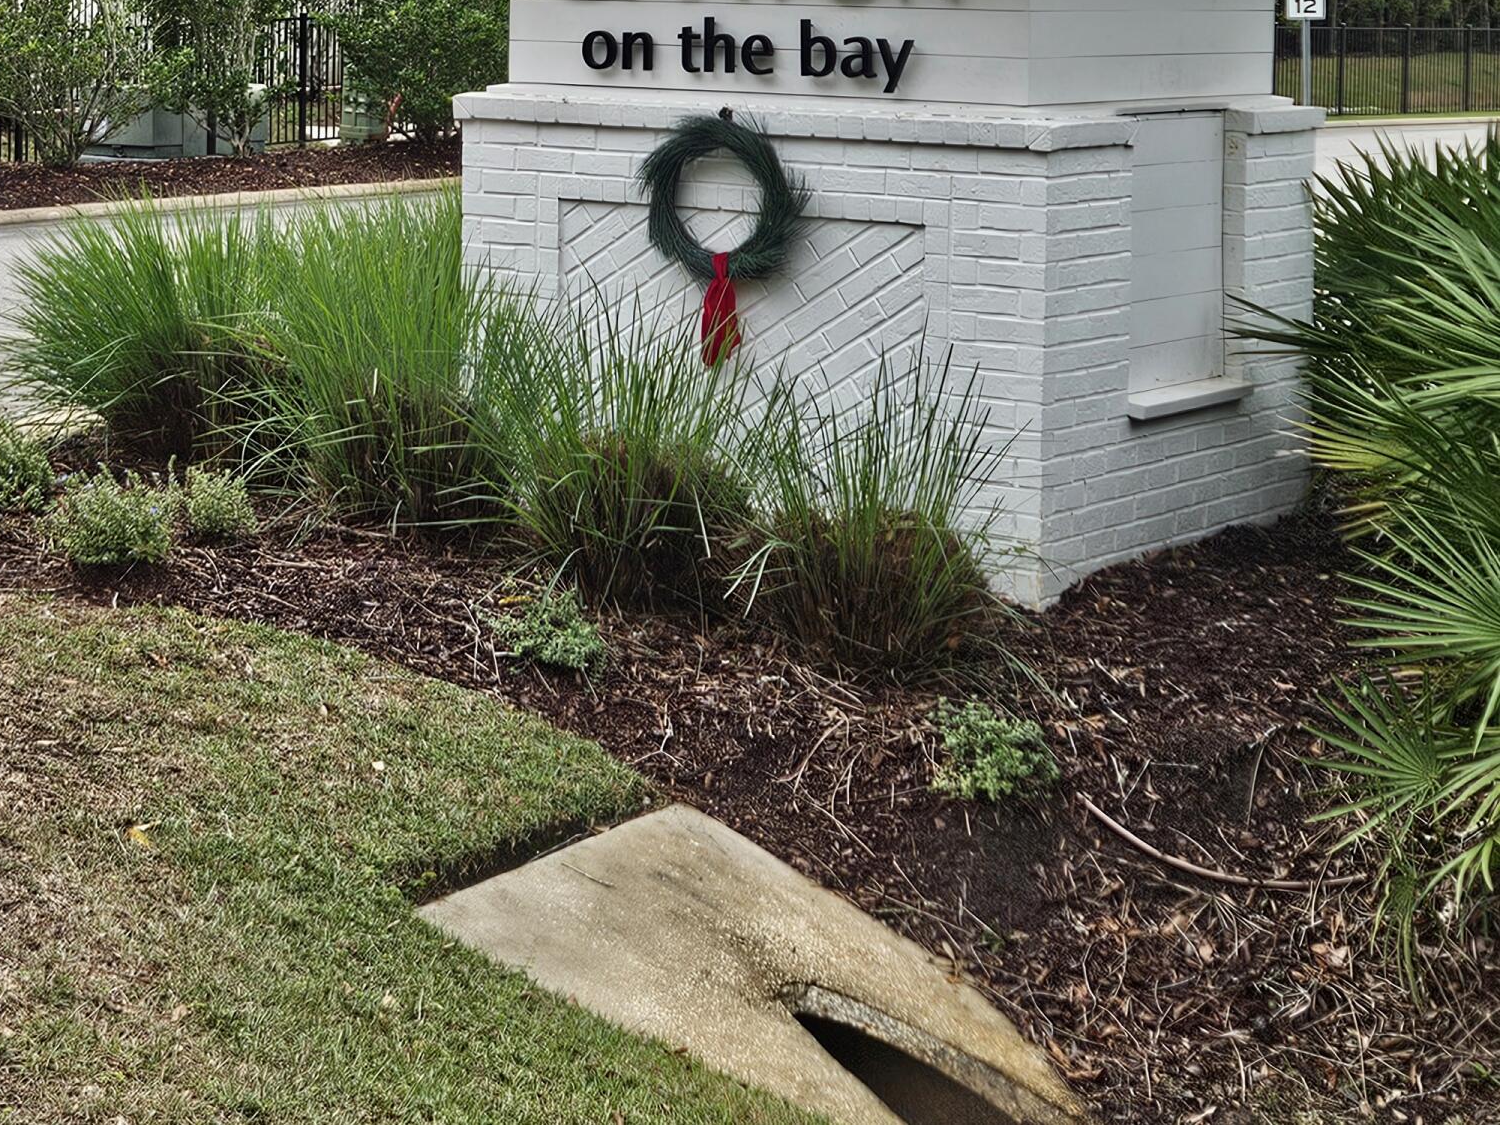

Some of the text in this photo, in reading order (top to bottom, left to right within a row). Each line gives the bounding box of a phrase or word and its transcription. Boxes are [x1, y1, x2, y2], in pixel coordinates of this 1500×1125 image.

[581, 16, 915, 94] on the bay
